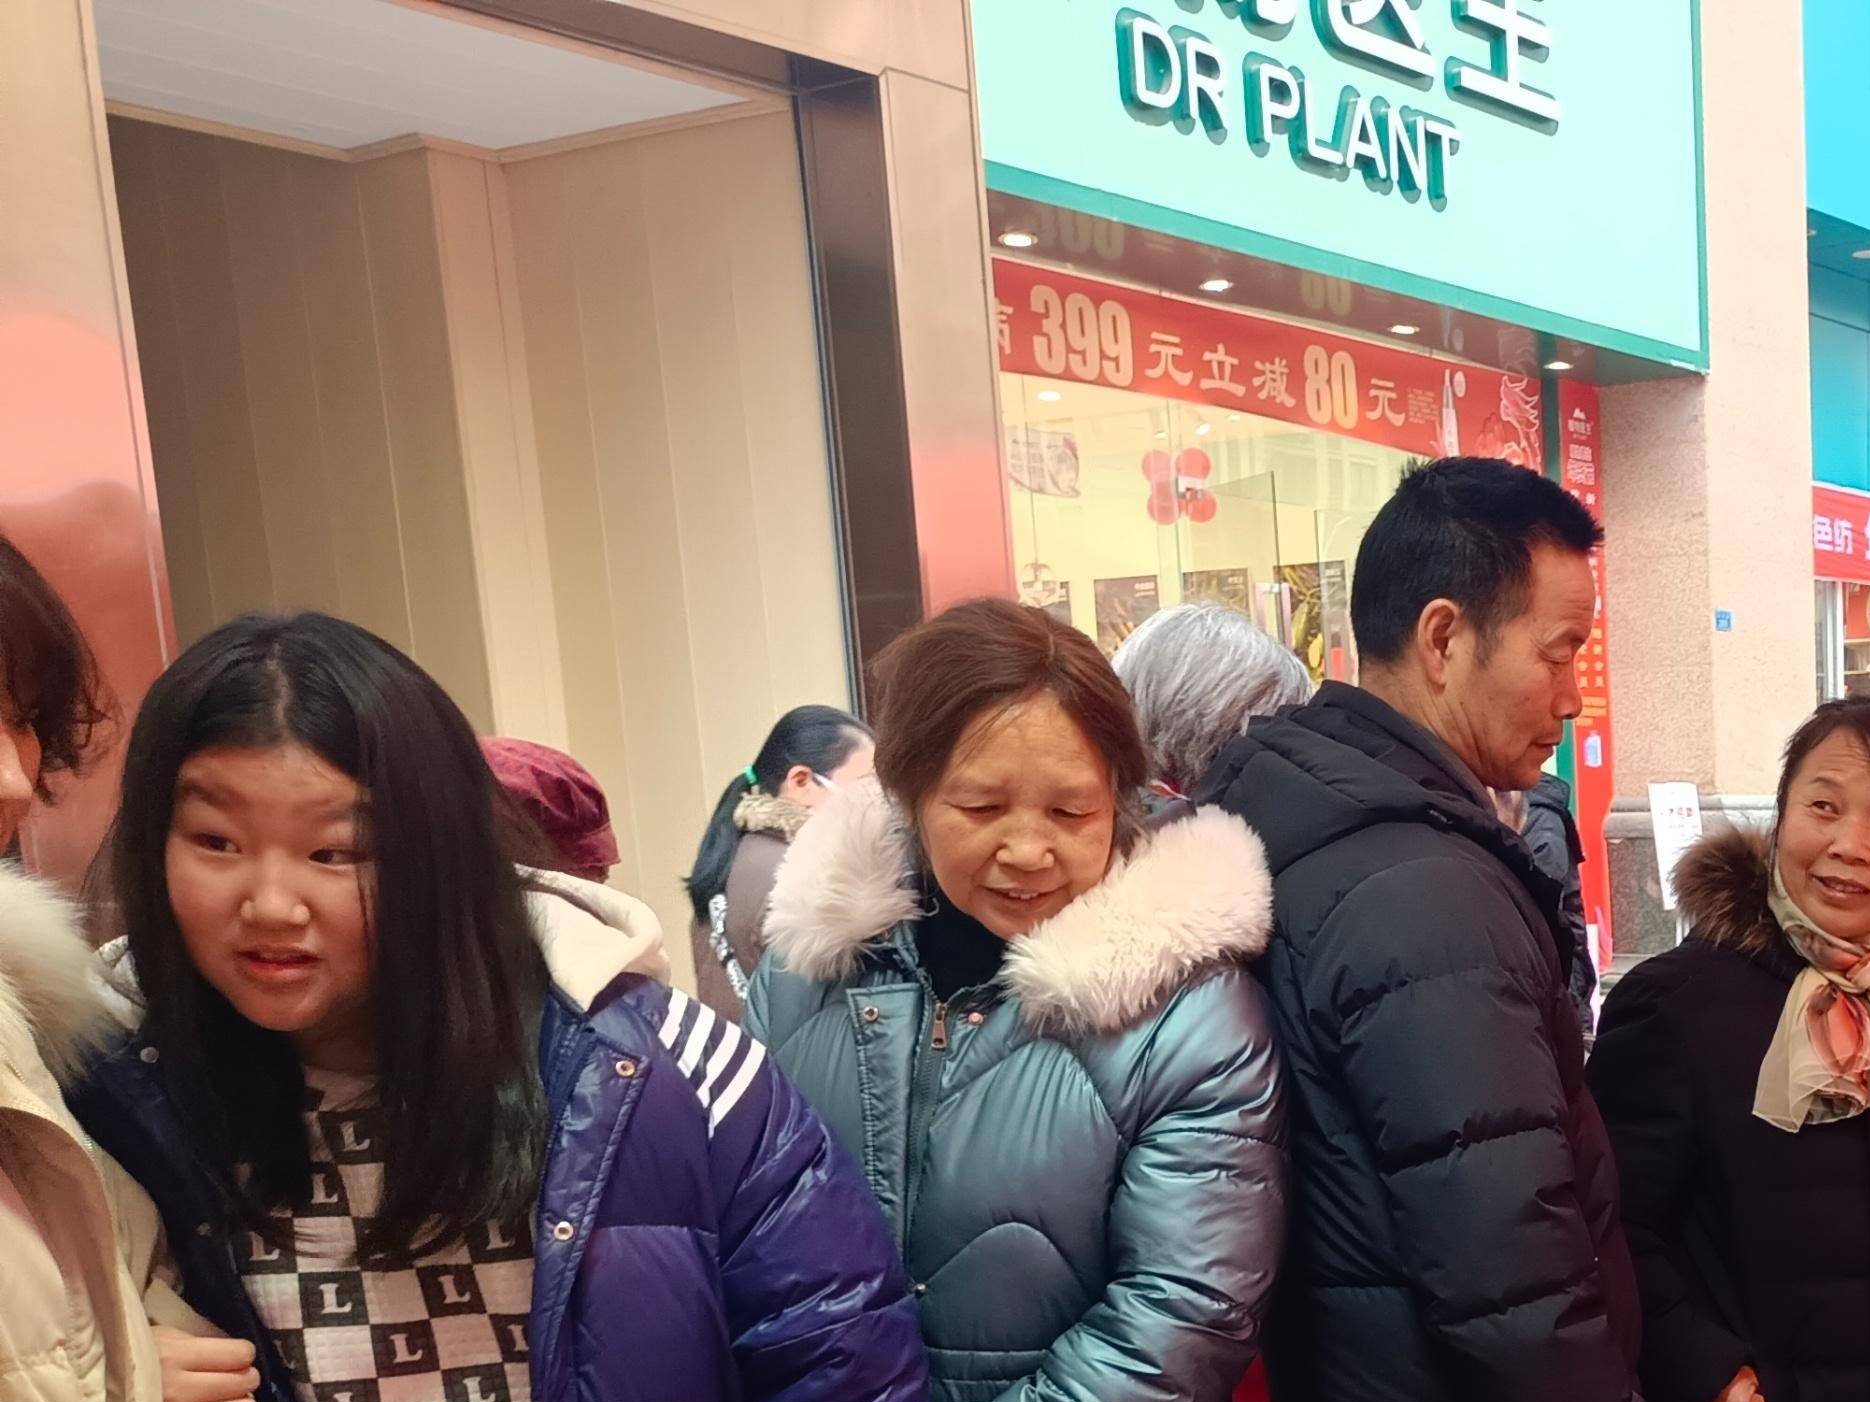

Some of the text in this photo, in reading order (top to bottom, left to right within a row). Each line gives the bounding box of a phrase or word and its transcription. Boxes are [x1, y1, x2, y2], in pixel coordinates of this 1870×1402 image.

[1128, 14, 1462, 200] DR PLANT
[339, 1121, 371, 1151] L
[311, 1173, 338, 1204] L
[319, 1283, 352, 1314] L
[438, 1274, 470, 1304] L
[390, 1333, 422, 1363] L
